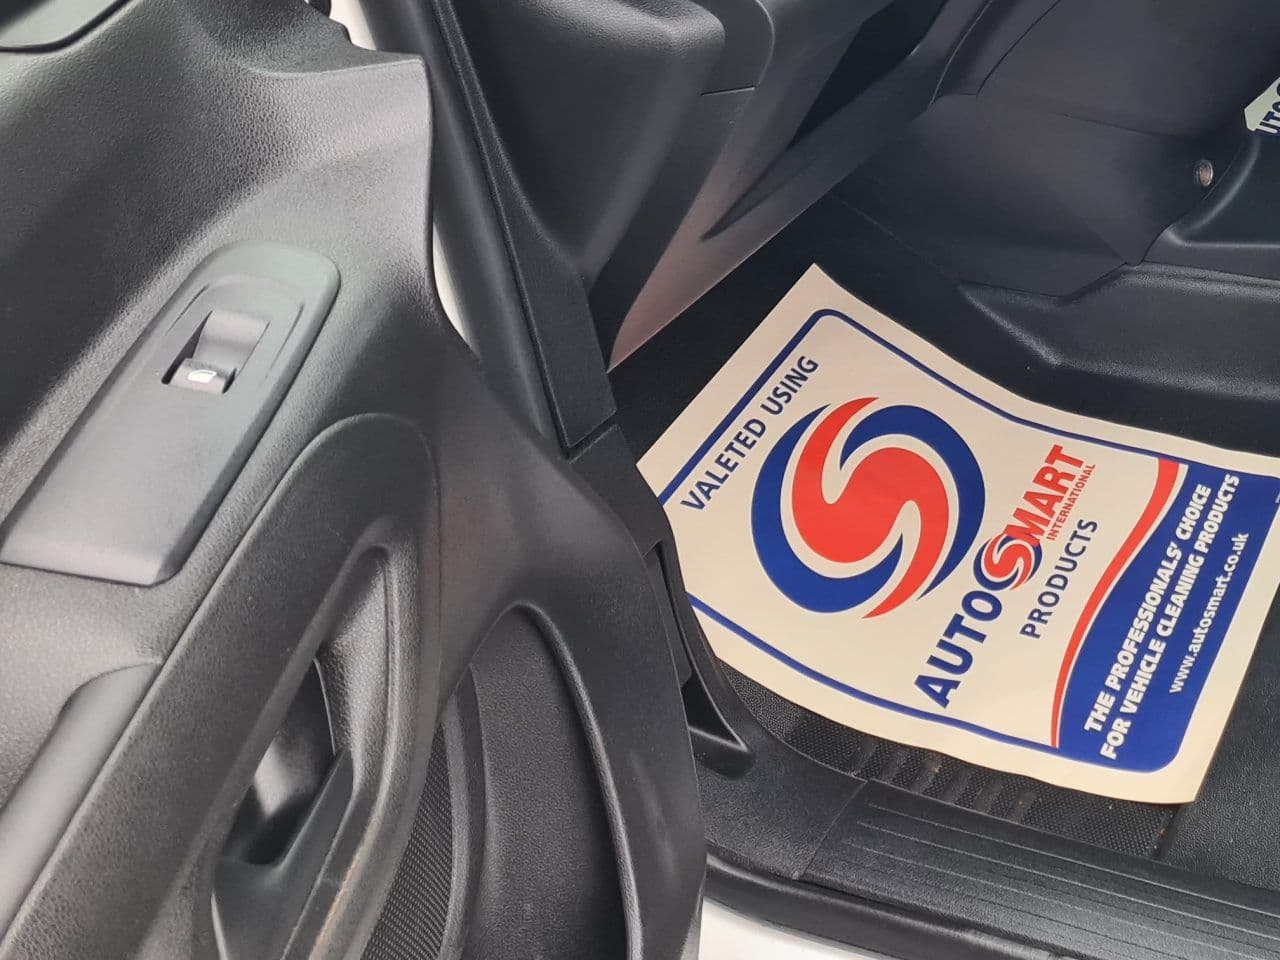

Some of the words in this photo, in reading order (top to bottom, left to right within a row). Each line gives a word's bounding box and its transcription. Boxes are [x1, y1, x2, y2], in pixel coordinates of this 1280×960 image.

[680, 418, 767, 510] VALETED
[760, 356, 819, 415] USING
[1046, 464, 1096, 541] INTERNATIONAL
[1019, 519, 1098, 639] PRODUCTS
[1084, 690, 1116, 732] THE
[1175, 483, 1212, 541] CHOICE
[1100, 717, 1132, 760] FOR
[1119, 638, 1167, 714] VEHICLE
[1156, 553, 1205, 637] CLEANING
[1194, 473, 1240, 554] PRODUCTS
[1169, 533, 1249, 693] www.autosmart.co.uk
